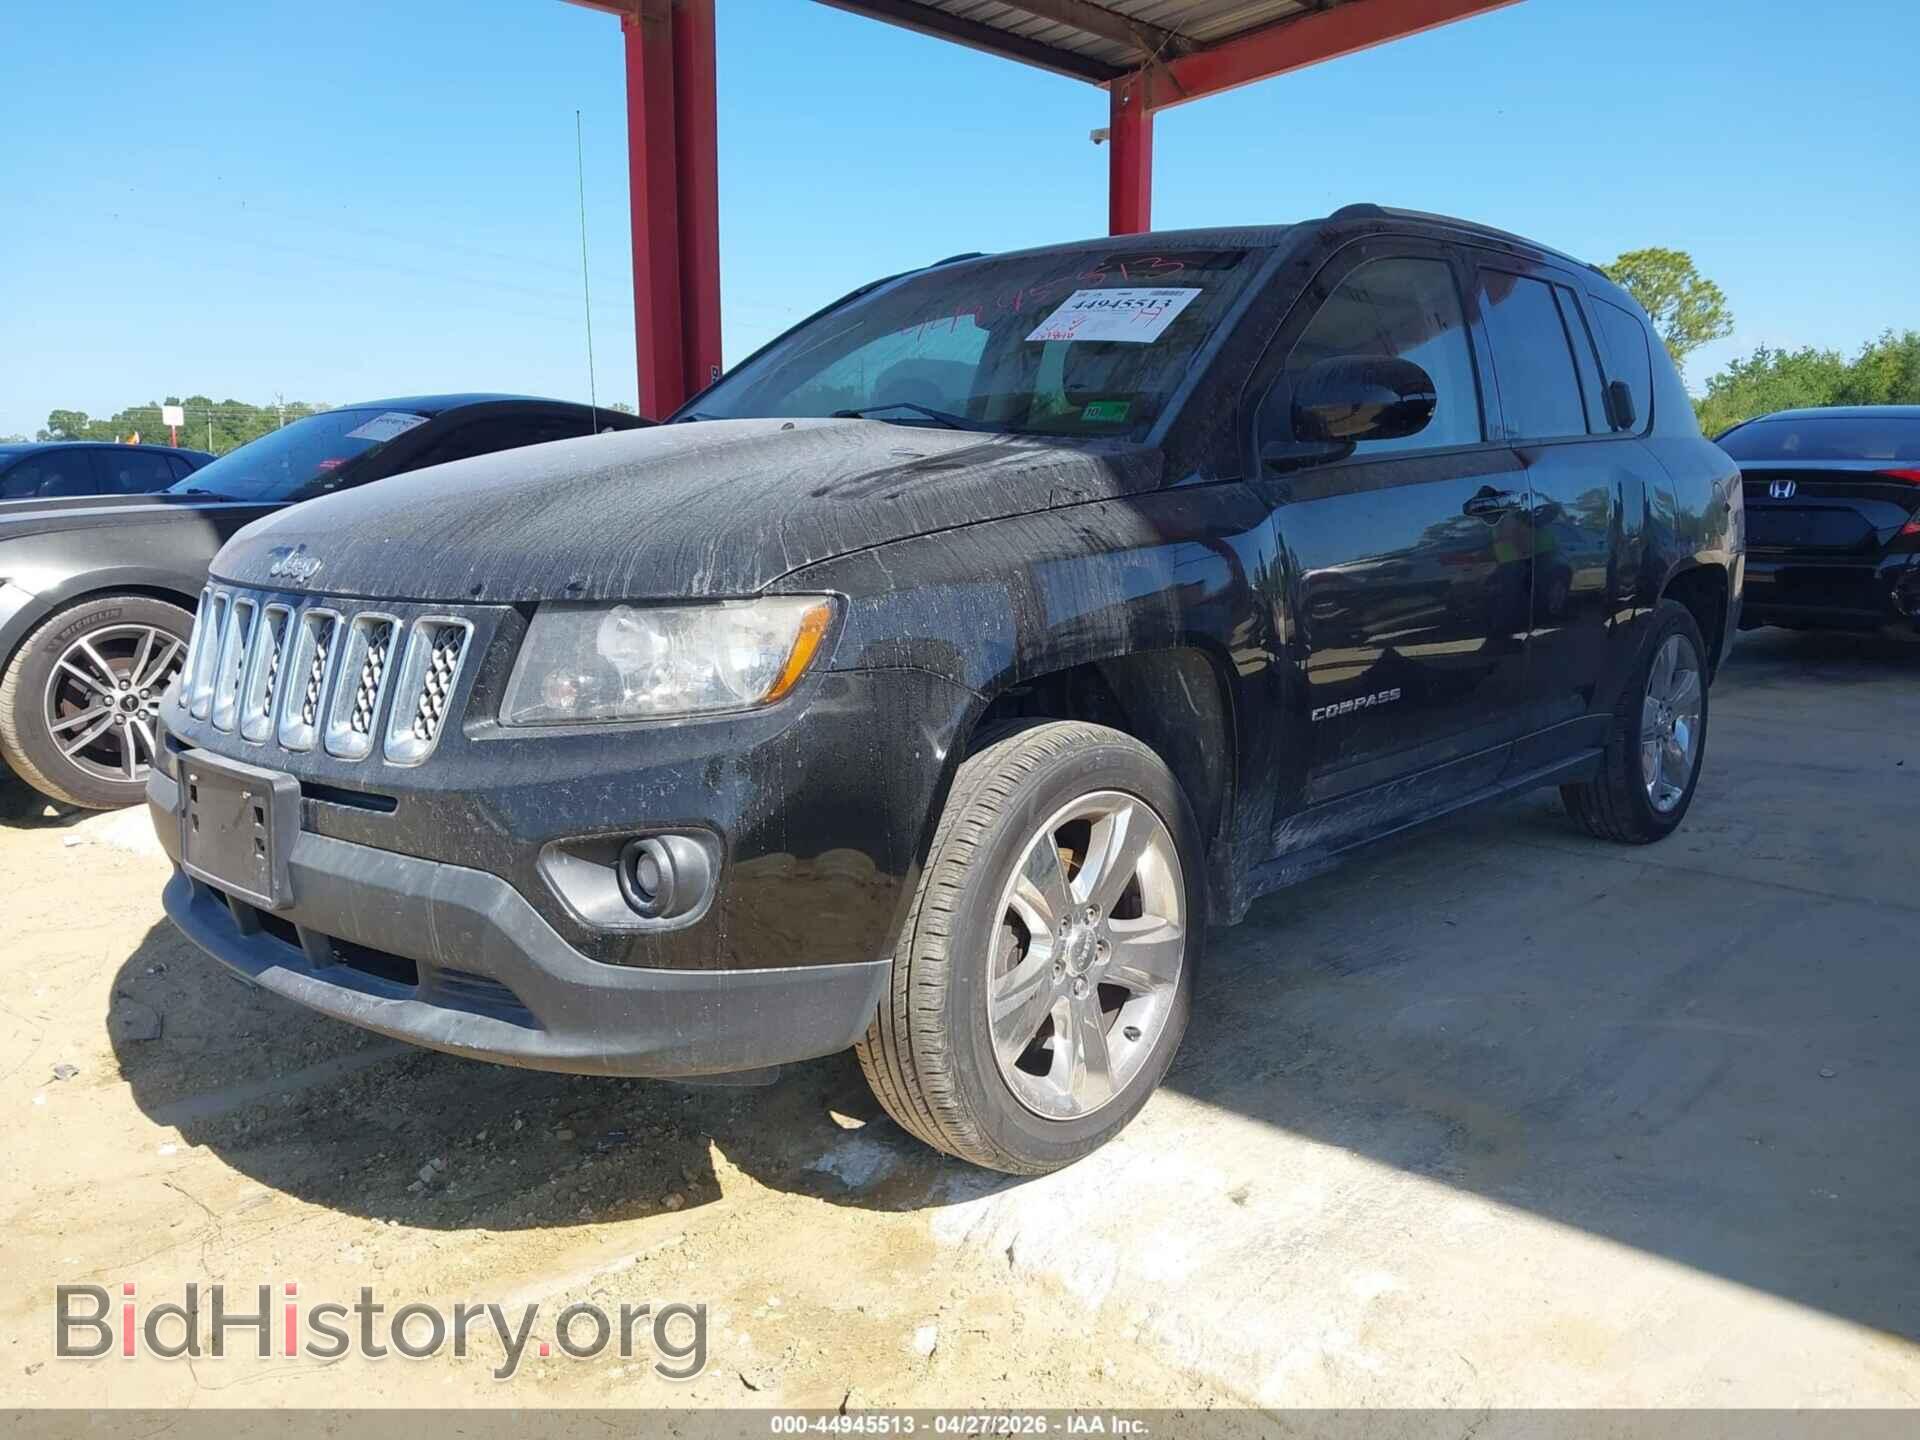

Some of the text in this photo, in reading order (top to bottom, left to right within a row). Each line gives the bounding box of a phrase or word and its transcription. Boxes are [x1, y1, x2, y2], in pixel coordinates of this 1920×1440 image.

[1072, 299, 1173, 310] 44945513
[271, 550, 321, 583] Jeep
[60, 608, 122, 640] MICHELIN
[1311, 687, 1401, 721] COMPASS
